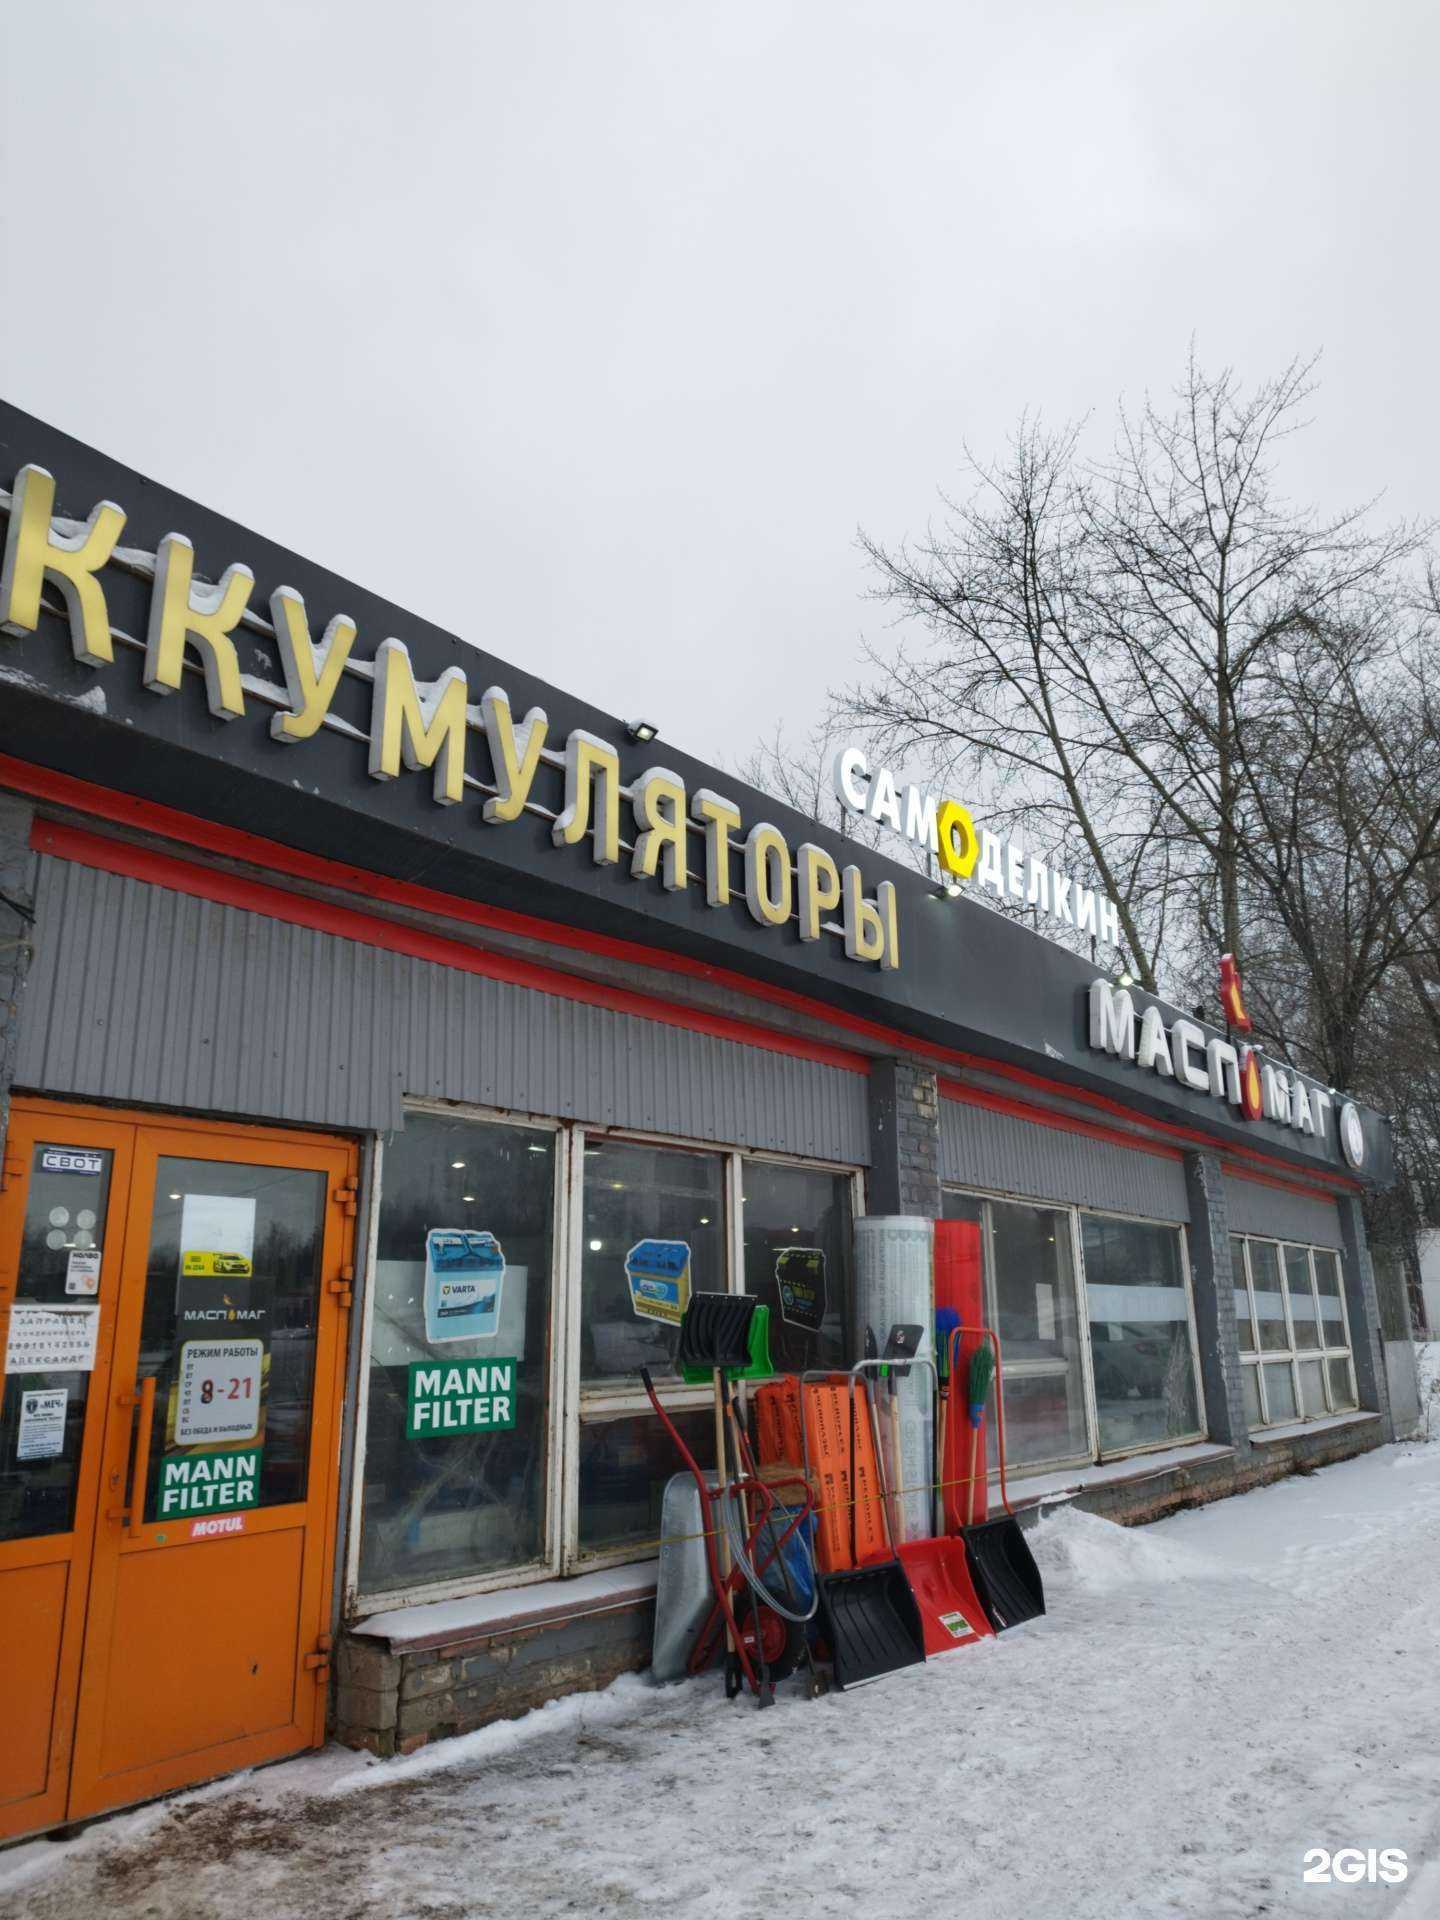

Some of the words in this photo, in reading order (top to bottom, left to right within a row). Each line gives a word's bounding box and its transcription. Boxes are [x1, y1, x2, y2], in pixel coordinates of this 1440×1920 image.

[833, 747, 1119, 947] САМОДЕЛКИН
[451, 1285, 476, 1294] VARTA
[187, 1348, 221, 1358] РЕЖИМ
[223, 1347, 258, 1357] РАБОТЫ
[414, 1365, 511, 1398] MANN
[413, 1396, 511, 1430] FILTER
[165, 1455, 256, 1486] MANN
[162, 1480, 254, 1513] FILTER
[192, 1517, 243, 1537] MOTUL
